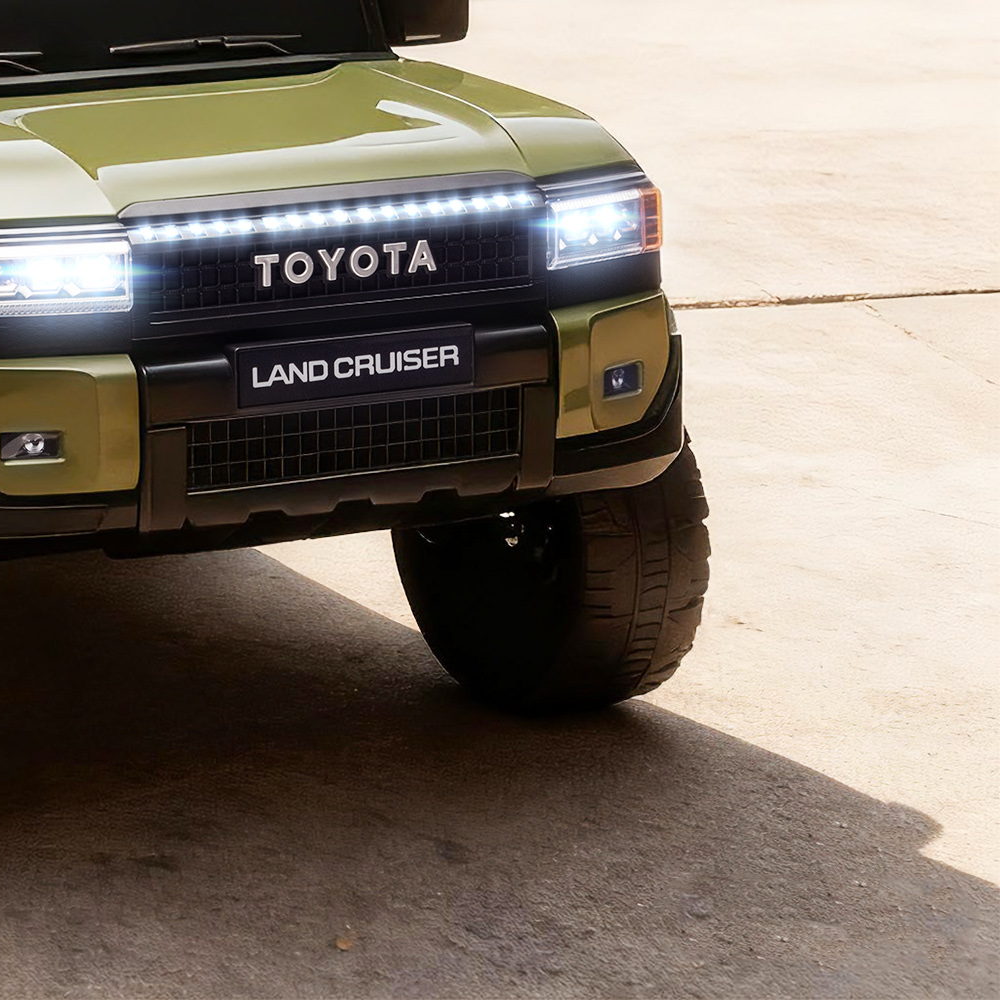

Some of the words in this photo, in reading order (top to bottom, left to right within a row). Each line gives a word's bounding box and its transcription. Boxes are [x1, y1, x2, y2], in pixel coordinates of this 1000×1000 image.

[254, 239, 437, 288] TOYOTA
[251, 359, 328, 389] LAND
[334, 345, 460, 379] CRUISER
